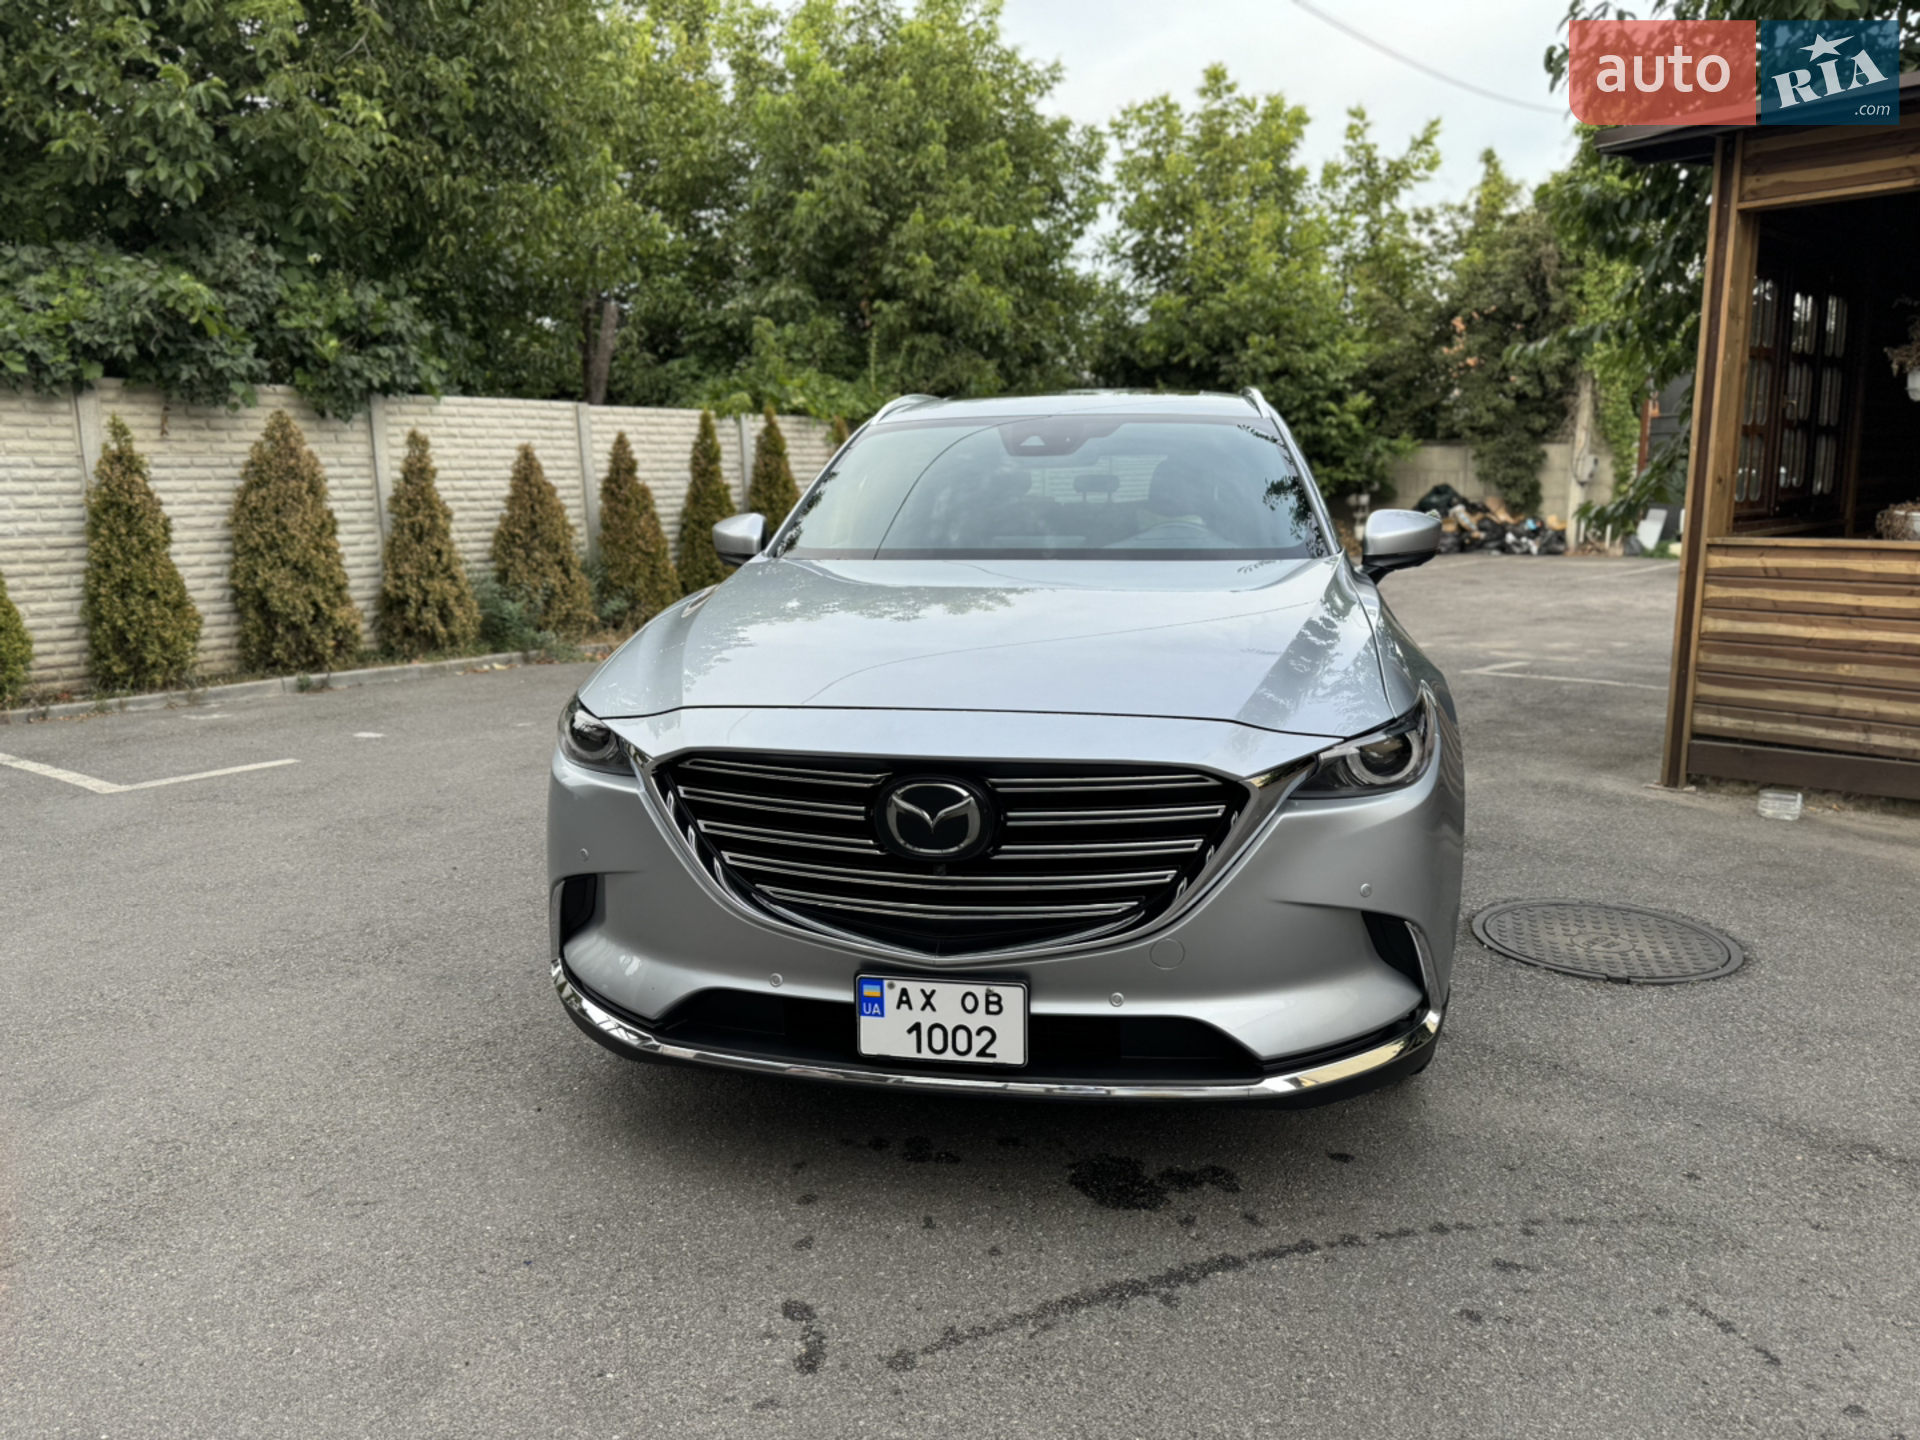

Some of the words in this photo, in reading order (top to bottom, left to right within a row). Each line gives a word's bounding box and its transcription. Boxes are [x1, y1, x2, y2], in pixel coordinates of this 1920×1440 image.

[863, 1002, 882, 1016] UA
[896, 987, 937, 1012] AX
[961, 991, 1004, 1016] OB
[906, 1021, 997, 1059] 1002
